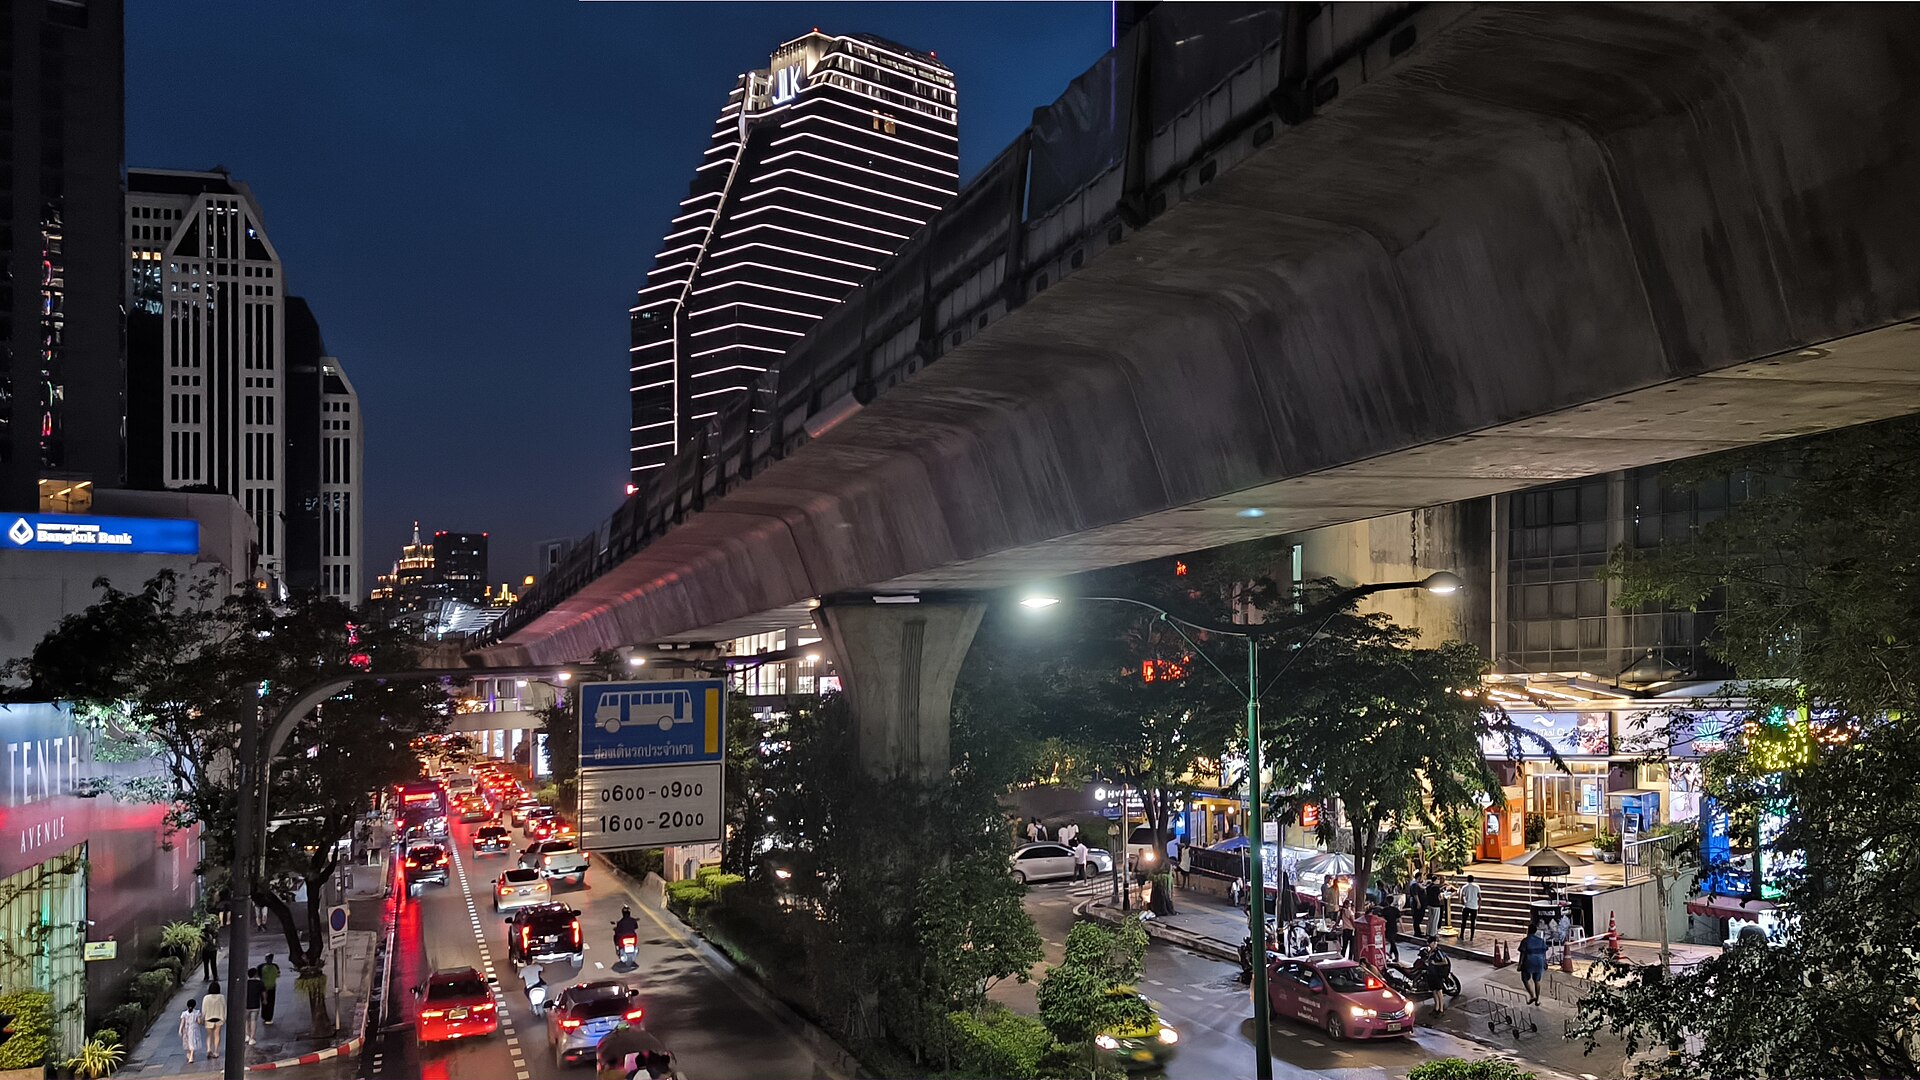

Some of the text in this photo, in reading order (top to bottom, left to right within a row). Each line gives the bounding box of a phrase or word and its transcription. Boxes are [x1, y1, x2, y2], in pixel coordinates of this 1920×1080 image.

[37, 530, 133, 545] Bangkok Bank
[7, 735, 79, 808] TENTH
[20, 816, 65, 854] AVENUE
